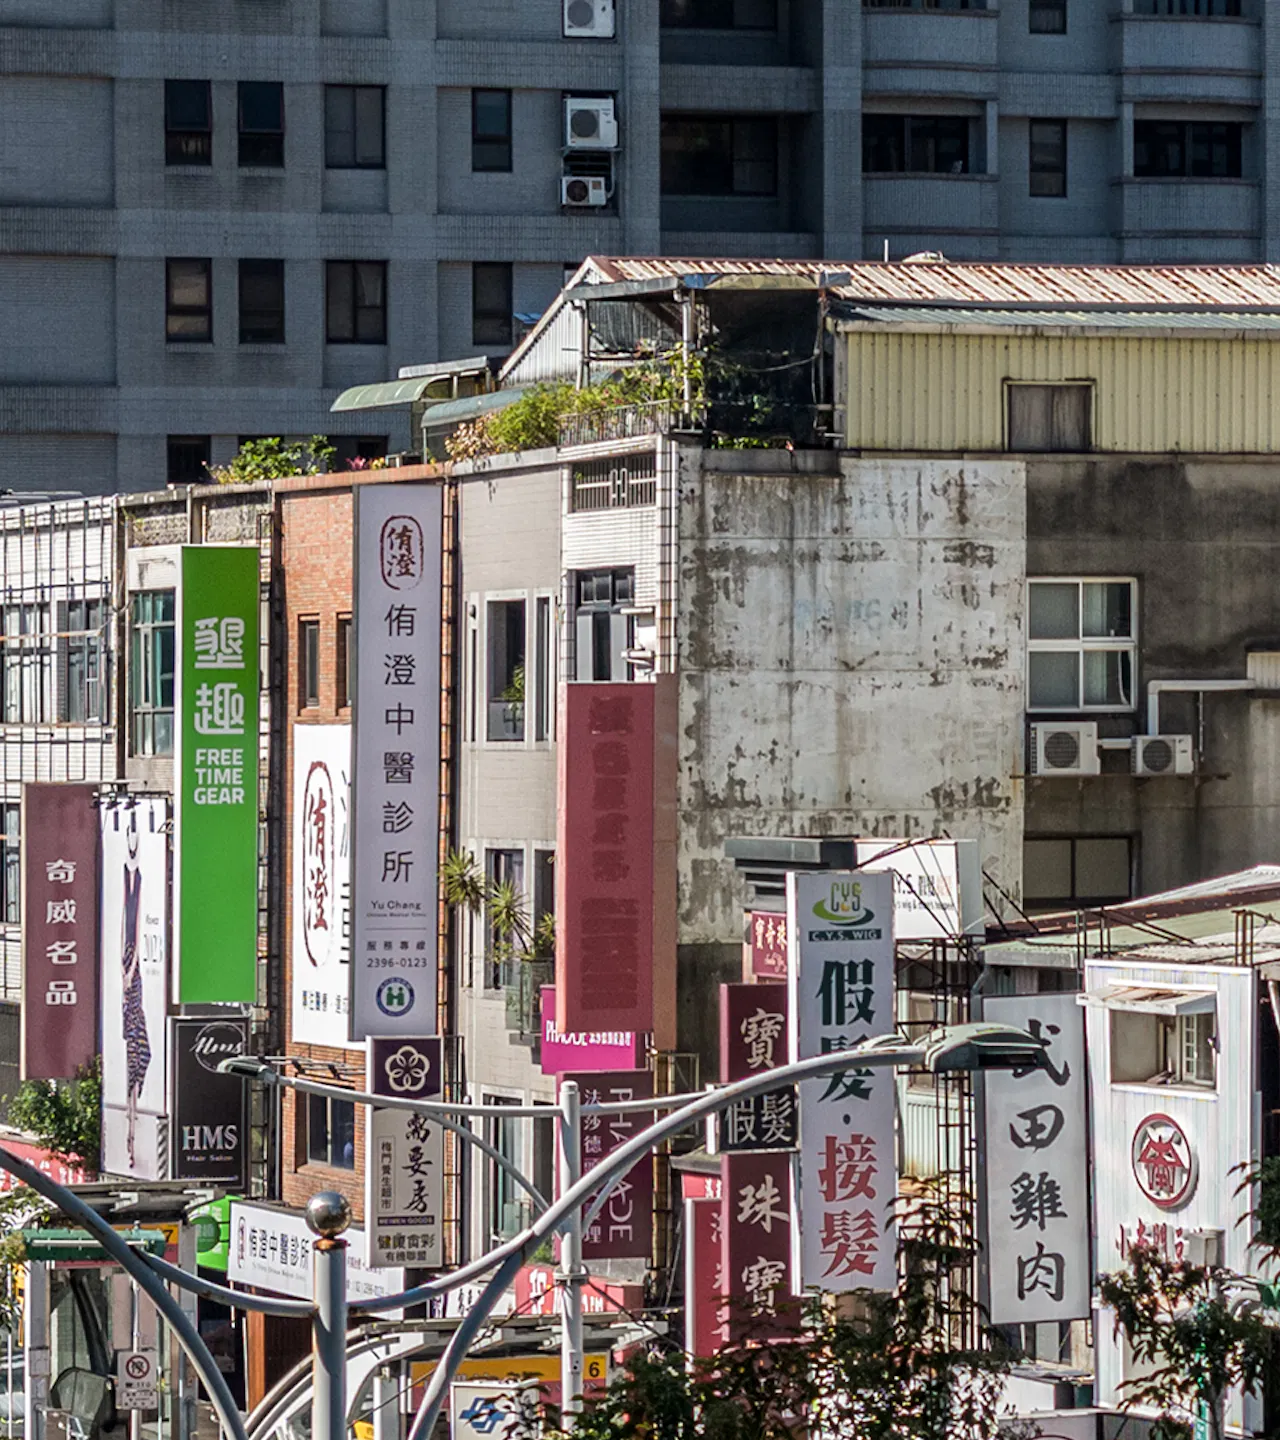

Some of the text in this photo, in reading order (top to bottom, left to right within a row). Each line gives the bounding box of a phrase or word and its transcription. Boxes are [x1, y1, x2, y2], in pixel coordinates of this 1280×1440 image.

[194, 616, 245, 736] 墾趣
[383, 602, 418, 886] 侑澄中醫診所
[194, 748, 244, 766] FREE
[194, 768, 244, 785] TIME
[194, 787, 245, 805] GEAR
[371, 900, 385, 911] Yu
[46, 859, 77, 1006] 奇威名品
[853, 930, 878, 940] WIG
[367, 957, 428, 968] 2396-0123
[724, 1091, 793, 1144] 假髮
[182, 1124, 238, 1151] HMS
[609, 1088, 633, 1242] PHAADE
[737, 1008, 790, 1318] 寶珠寶
[589, 1361, 600, 1378] 6
